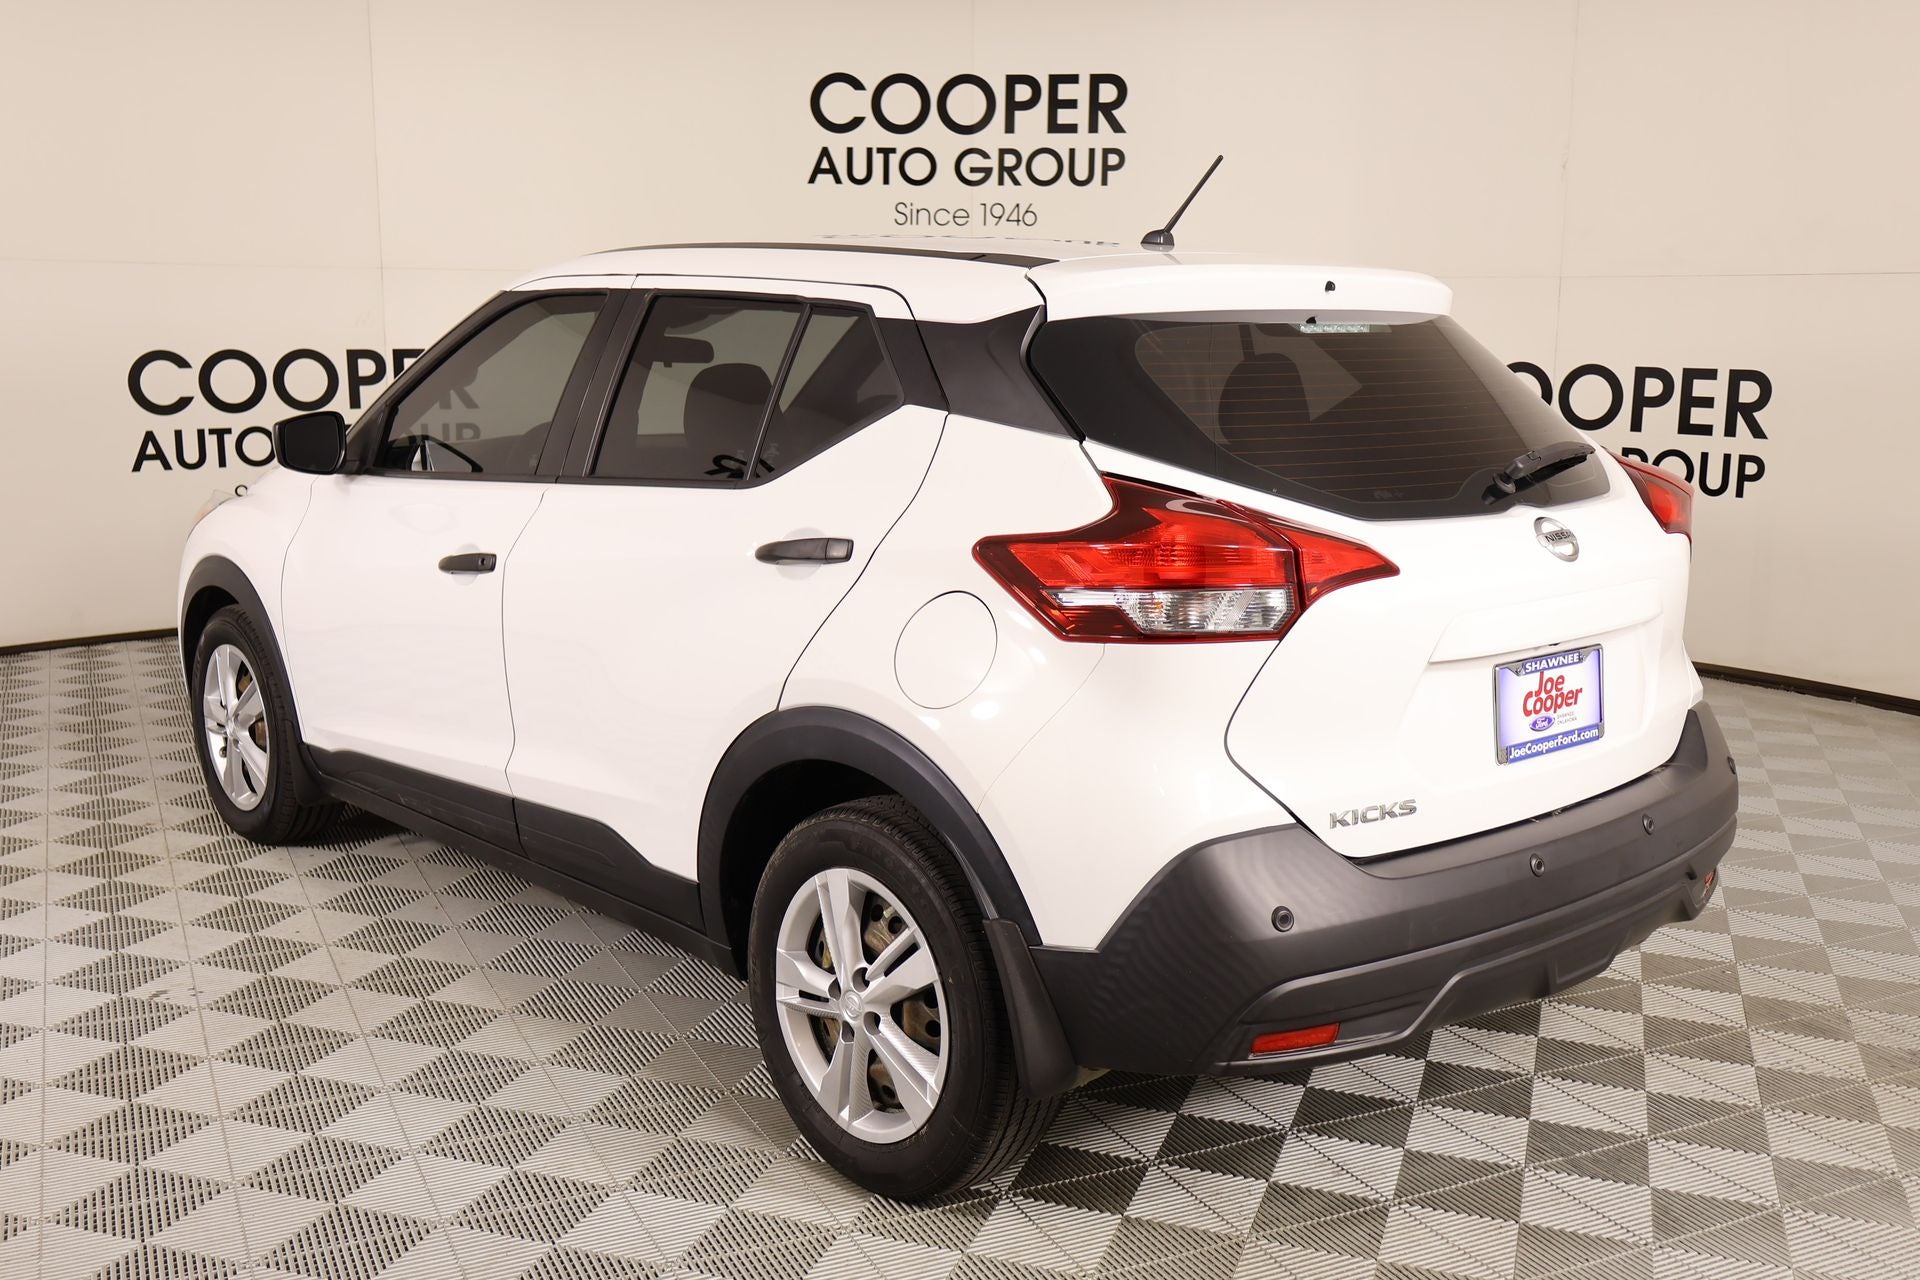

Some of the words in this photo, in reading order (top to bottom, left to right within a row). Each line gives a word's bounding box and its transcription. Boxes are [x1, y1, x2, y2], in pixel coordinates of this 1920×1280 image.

[809, 72, 1128, 135] COOPER
[808, 147, 938, 187] AUTO
[954, 147, 1126, 187] GROUP
[894, 202, 970, 227] Since
[980, 203, 1038, 227] 1946
[131, 425, 274, 473] AUTO
[1525, 652, 1580, 673] SHAWNEE
[1534, 671, 1565, 697] Joe
[1522, 687, 1583, 717] Cooper
[1509, 728, 1599, 759] JoeCooperFord.com
[1330, 798, 1418, 830] KICKS
